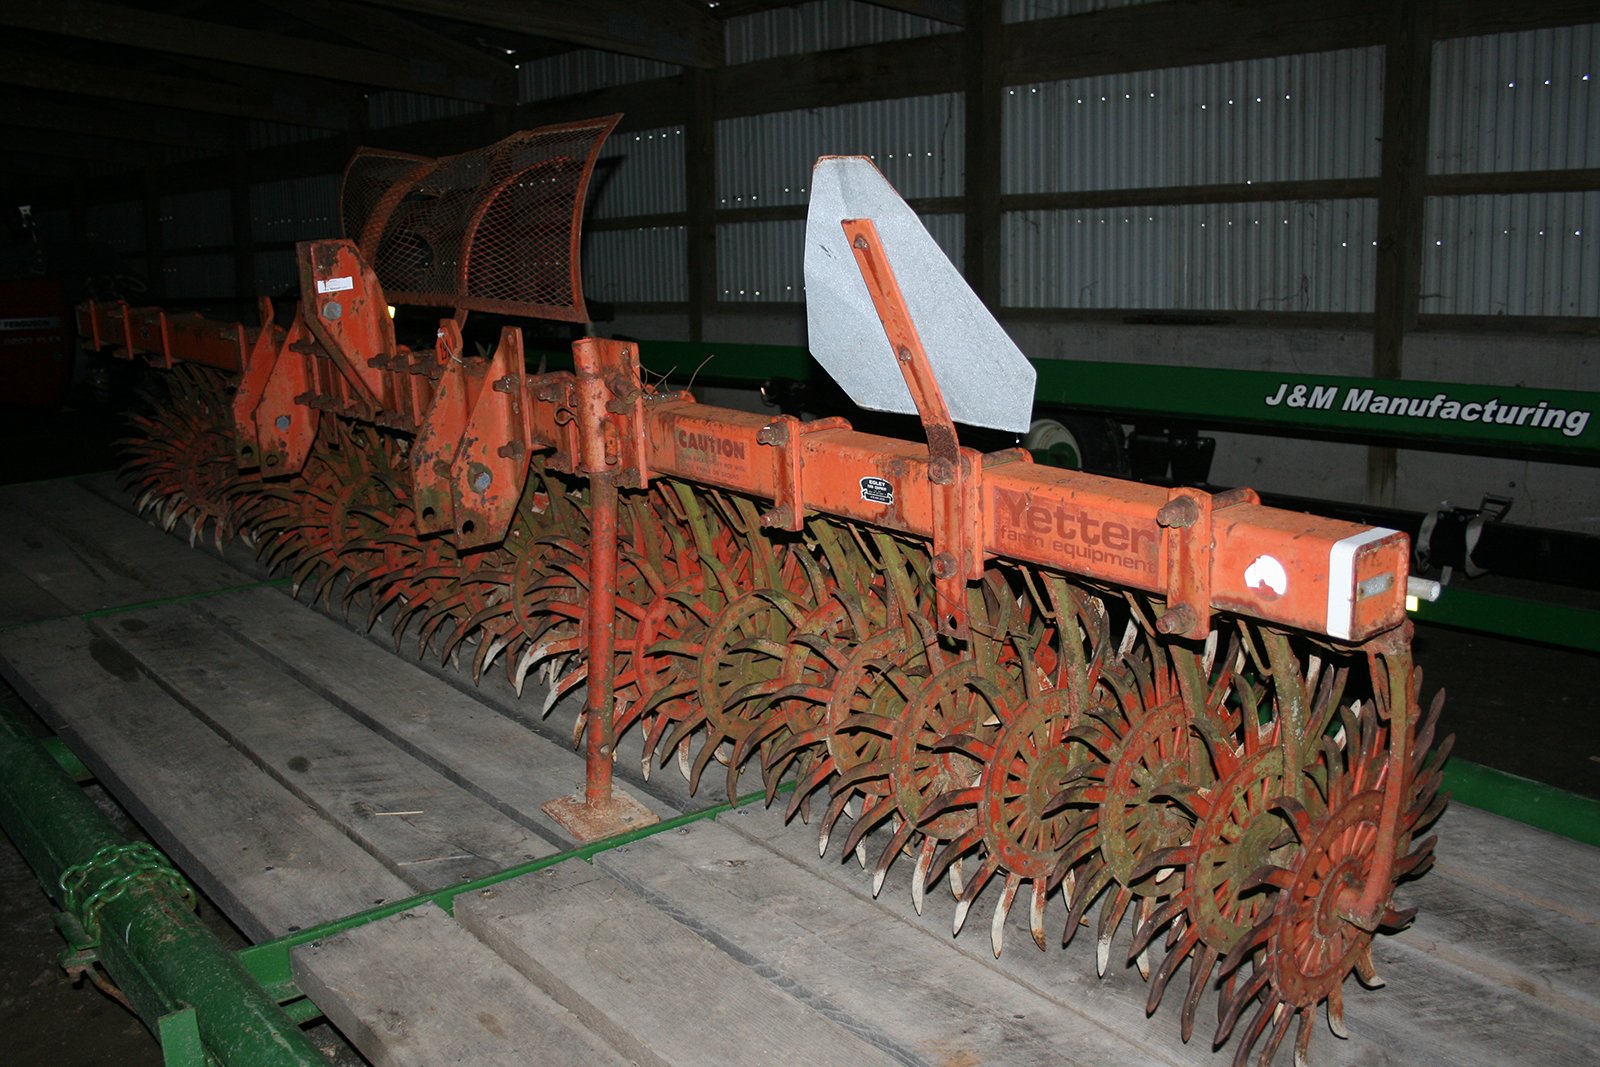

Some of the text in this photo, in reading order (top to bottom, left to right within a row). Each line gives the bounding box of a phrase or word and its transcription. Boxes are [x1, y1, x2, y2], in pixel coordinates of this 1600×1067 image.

[1265, 383, 1591, 437] J&M Manufacturing
[678, 429, 745, 460] CAUTION
[998, 487, 1156, 554] Yetter
[1000, 525, 1158, 573] farm equipment
